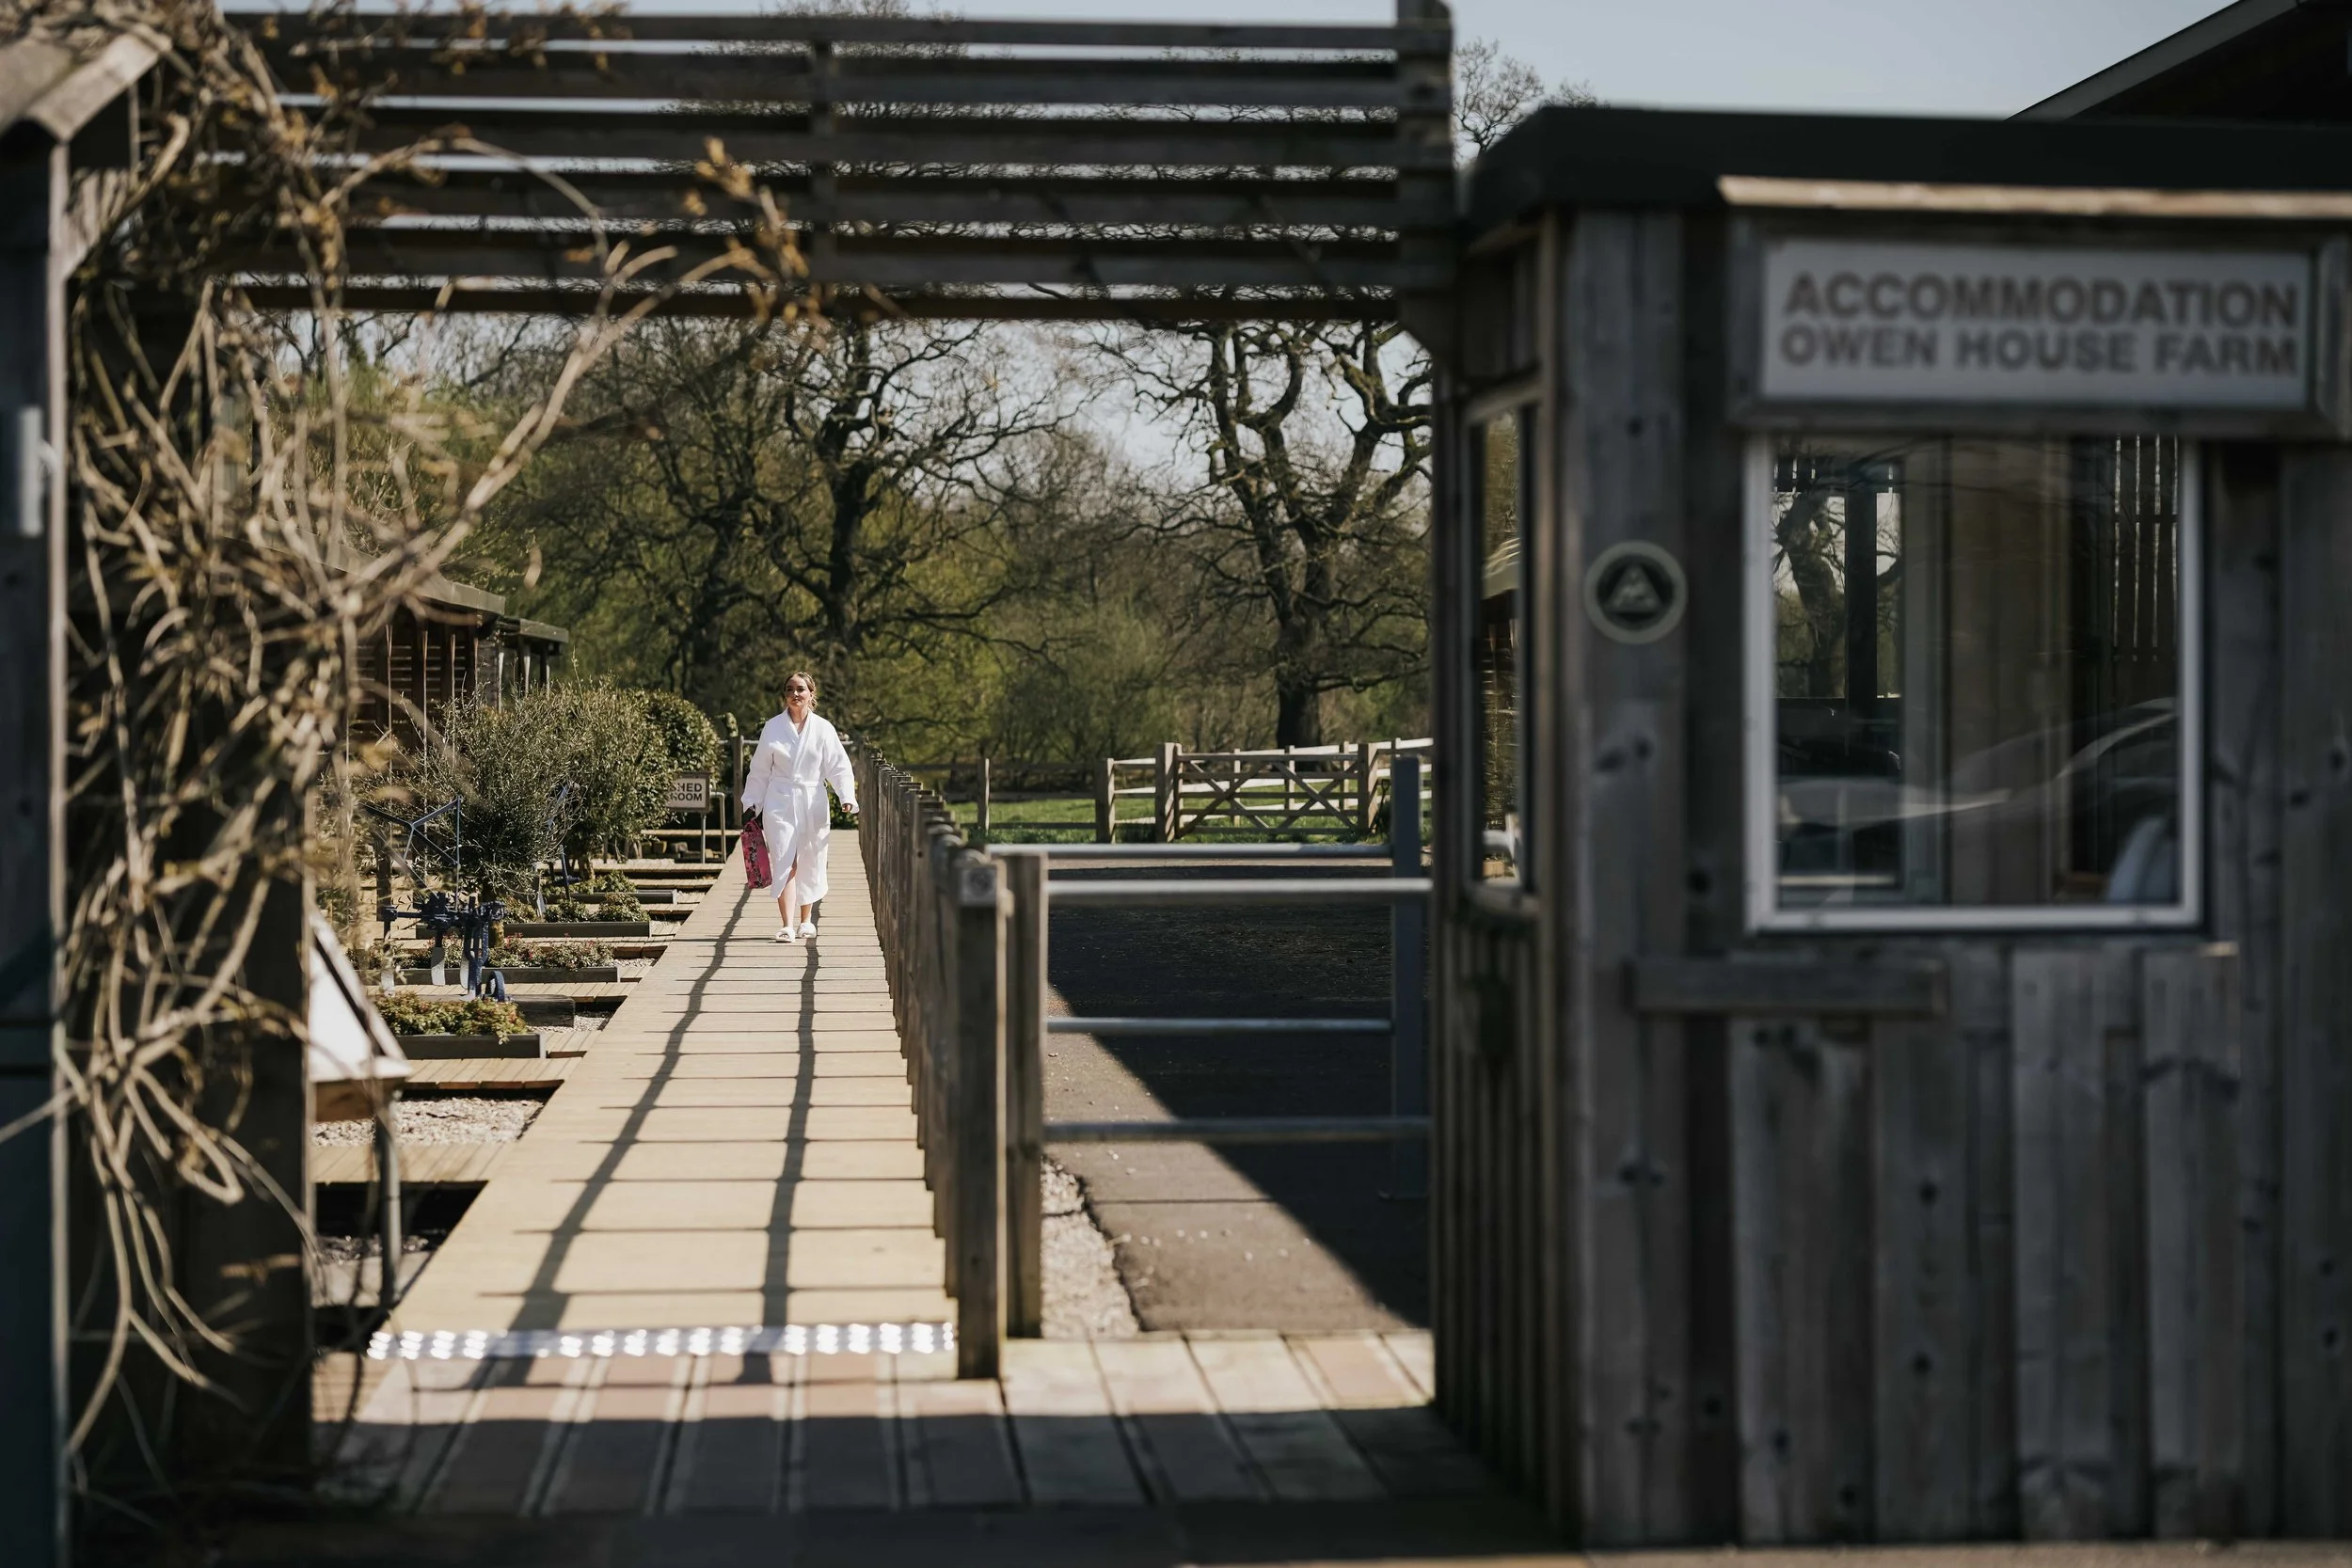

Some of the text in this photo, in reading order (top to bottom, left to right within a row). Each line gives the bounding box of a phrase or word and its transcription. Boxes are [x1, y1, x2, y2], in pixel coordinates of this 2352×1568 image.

[1783, 270, 2298, 328] ACCOMMODATION
[1779, 325, 2298, 375] OWEN HOUSE FARM
